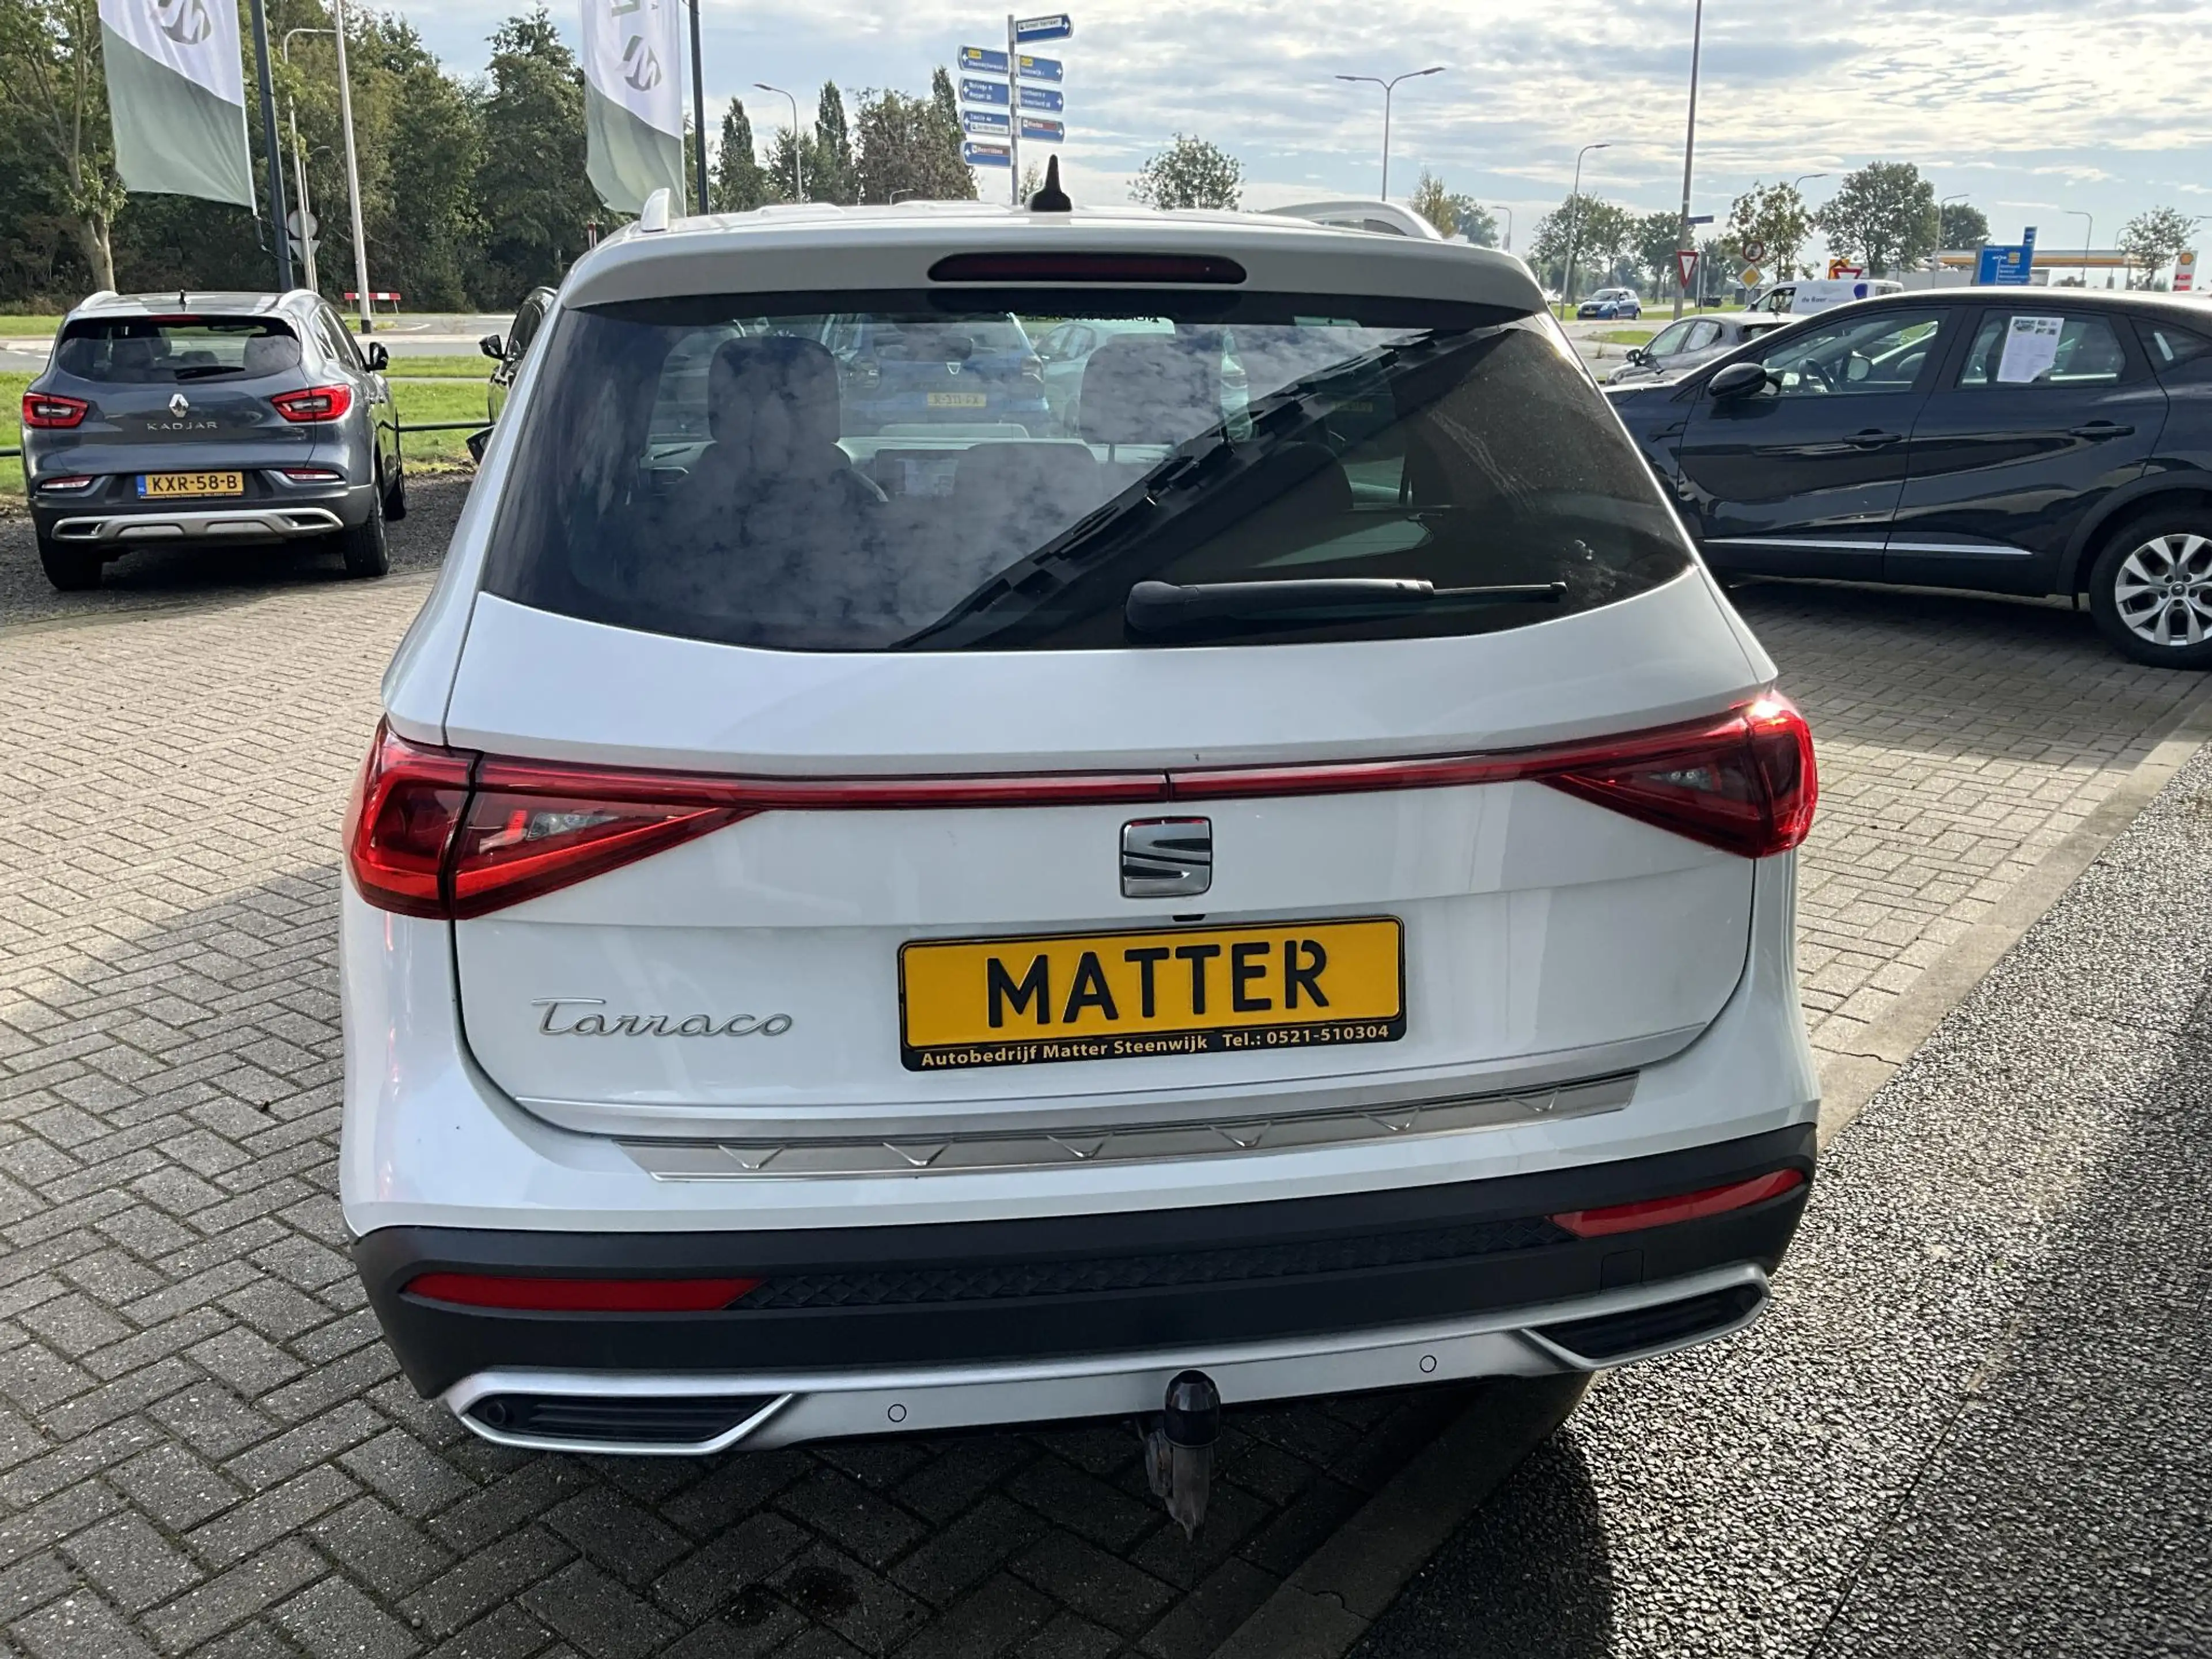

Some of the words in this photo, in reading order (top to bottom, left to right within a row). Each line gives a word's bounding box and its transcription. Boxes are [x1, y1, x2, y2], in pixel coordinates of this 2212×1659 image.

[147, 421, 218, 431] KADJAR
[152, 475, 238, 492] KXR-58-B
[987, 940, 1330, 1028] MATTER
[530, 997, 793, 1037] Tarraco
[922, 1046, 1037, 1066] Autobedrijf
[1043, 1042, 1108, 1058] Matter
[1114, 1036, 1208, 1054] Steenwijk
[1222, 1033, 1261, 1047] Tel.:
[1267, 1025, 1389, 1044] 0521-510304
